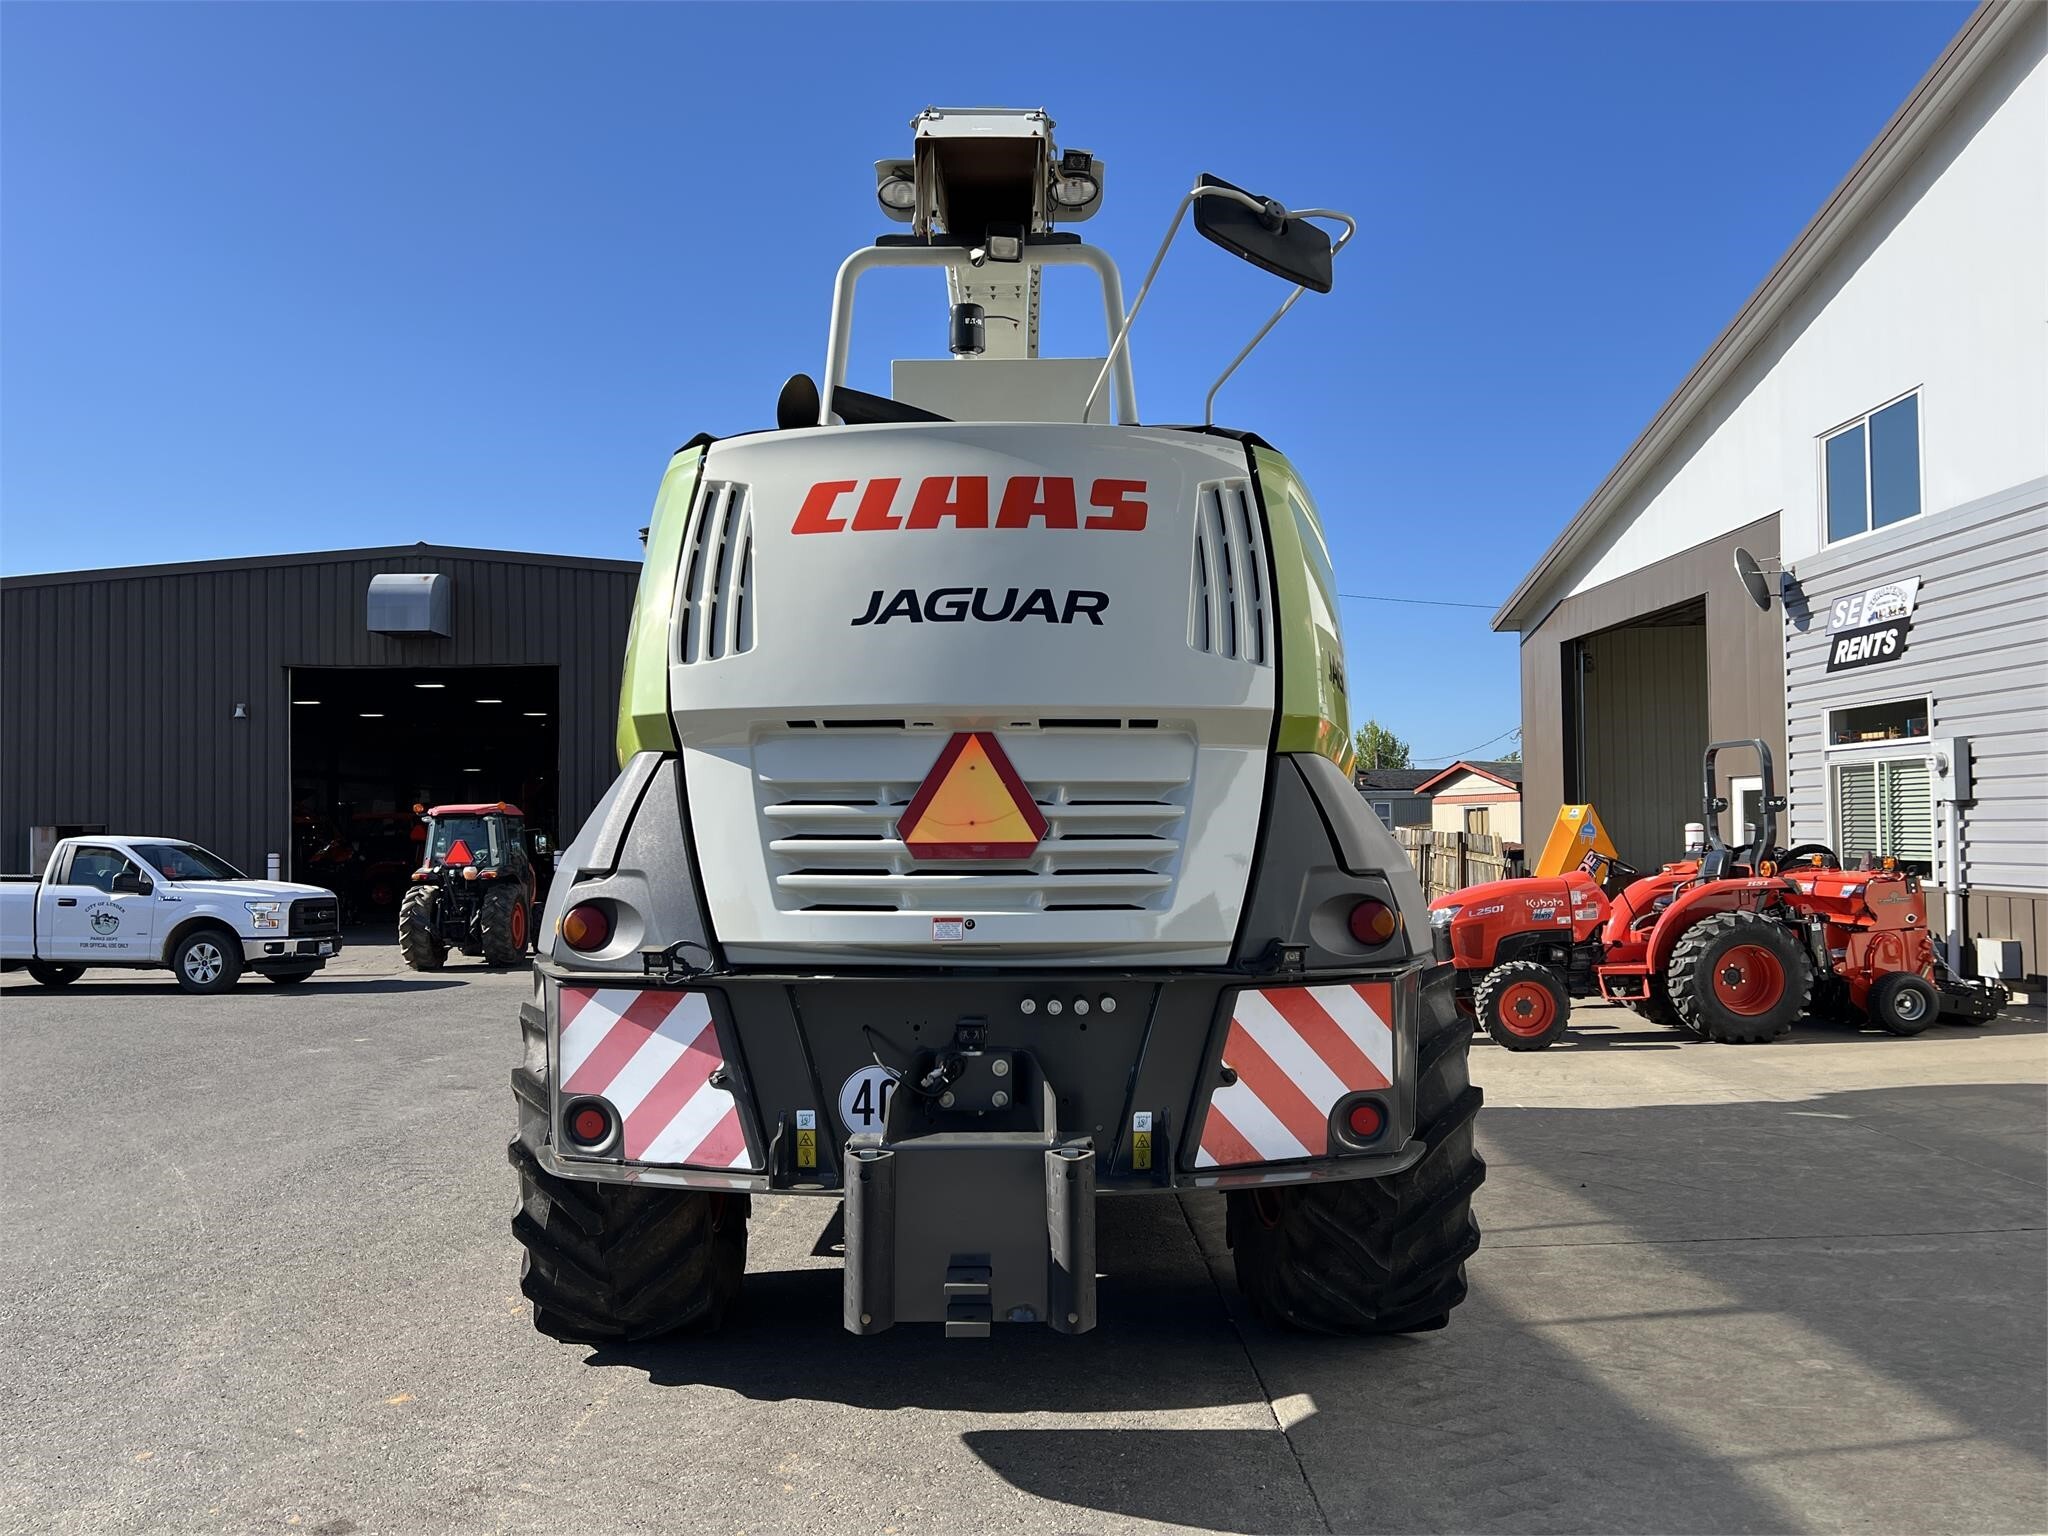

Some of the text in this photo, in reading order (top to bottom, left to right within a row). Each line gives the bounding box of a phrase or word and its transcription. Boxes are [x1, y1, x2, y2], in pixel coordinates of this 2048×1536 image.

[791, 476, 1149, 535] CLAAS
[851, 587, 1110, 626] JAGUAR
[1831, 596, 1864, 629] SE
[1833, 628, 1899, 665] RENTS
[1468, 905, 1505, 917] L2501
[1526, 898, 1564, 908] Kubota
